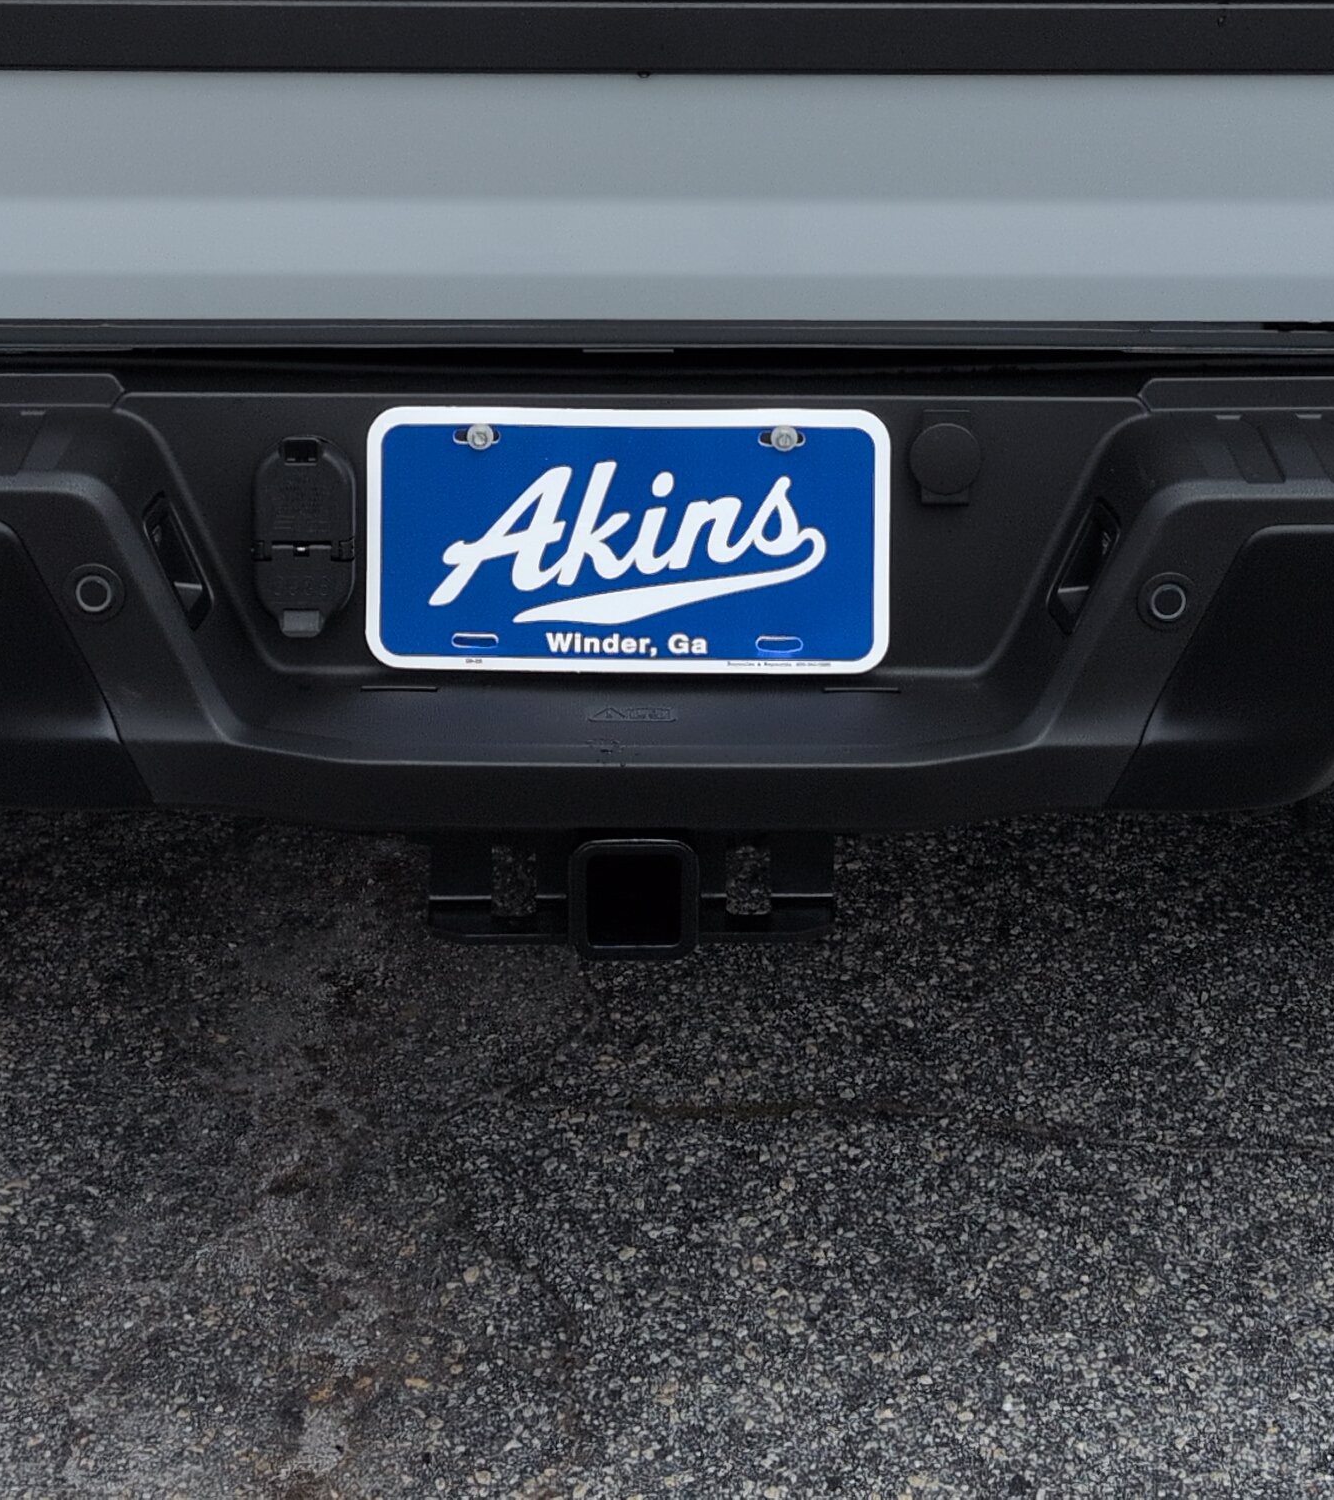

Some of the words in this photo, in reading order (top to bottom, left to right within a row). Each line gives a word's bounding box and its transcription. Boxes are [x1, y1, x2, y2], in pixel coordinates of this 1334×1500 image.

[428, 460, 826, 613] Akins
[545, 632, 658, 657] Winder,
[667, 633, 708, 655] Ga
